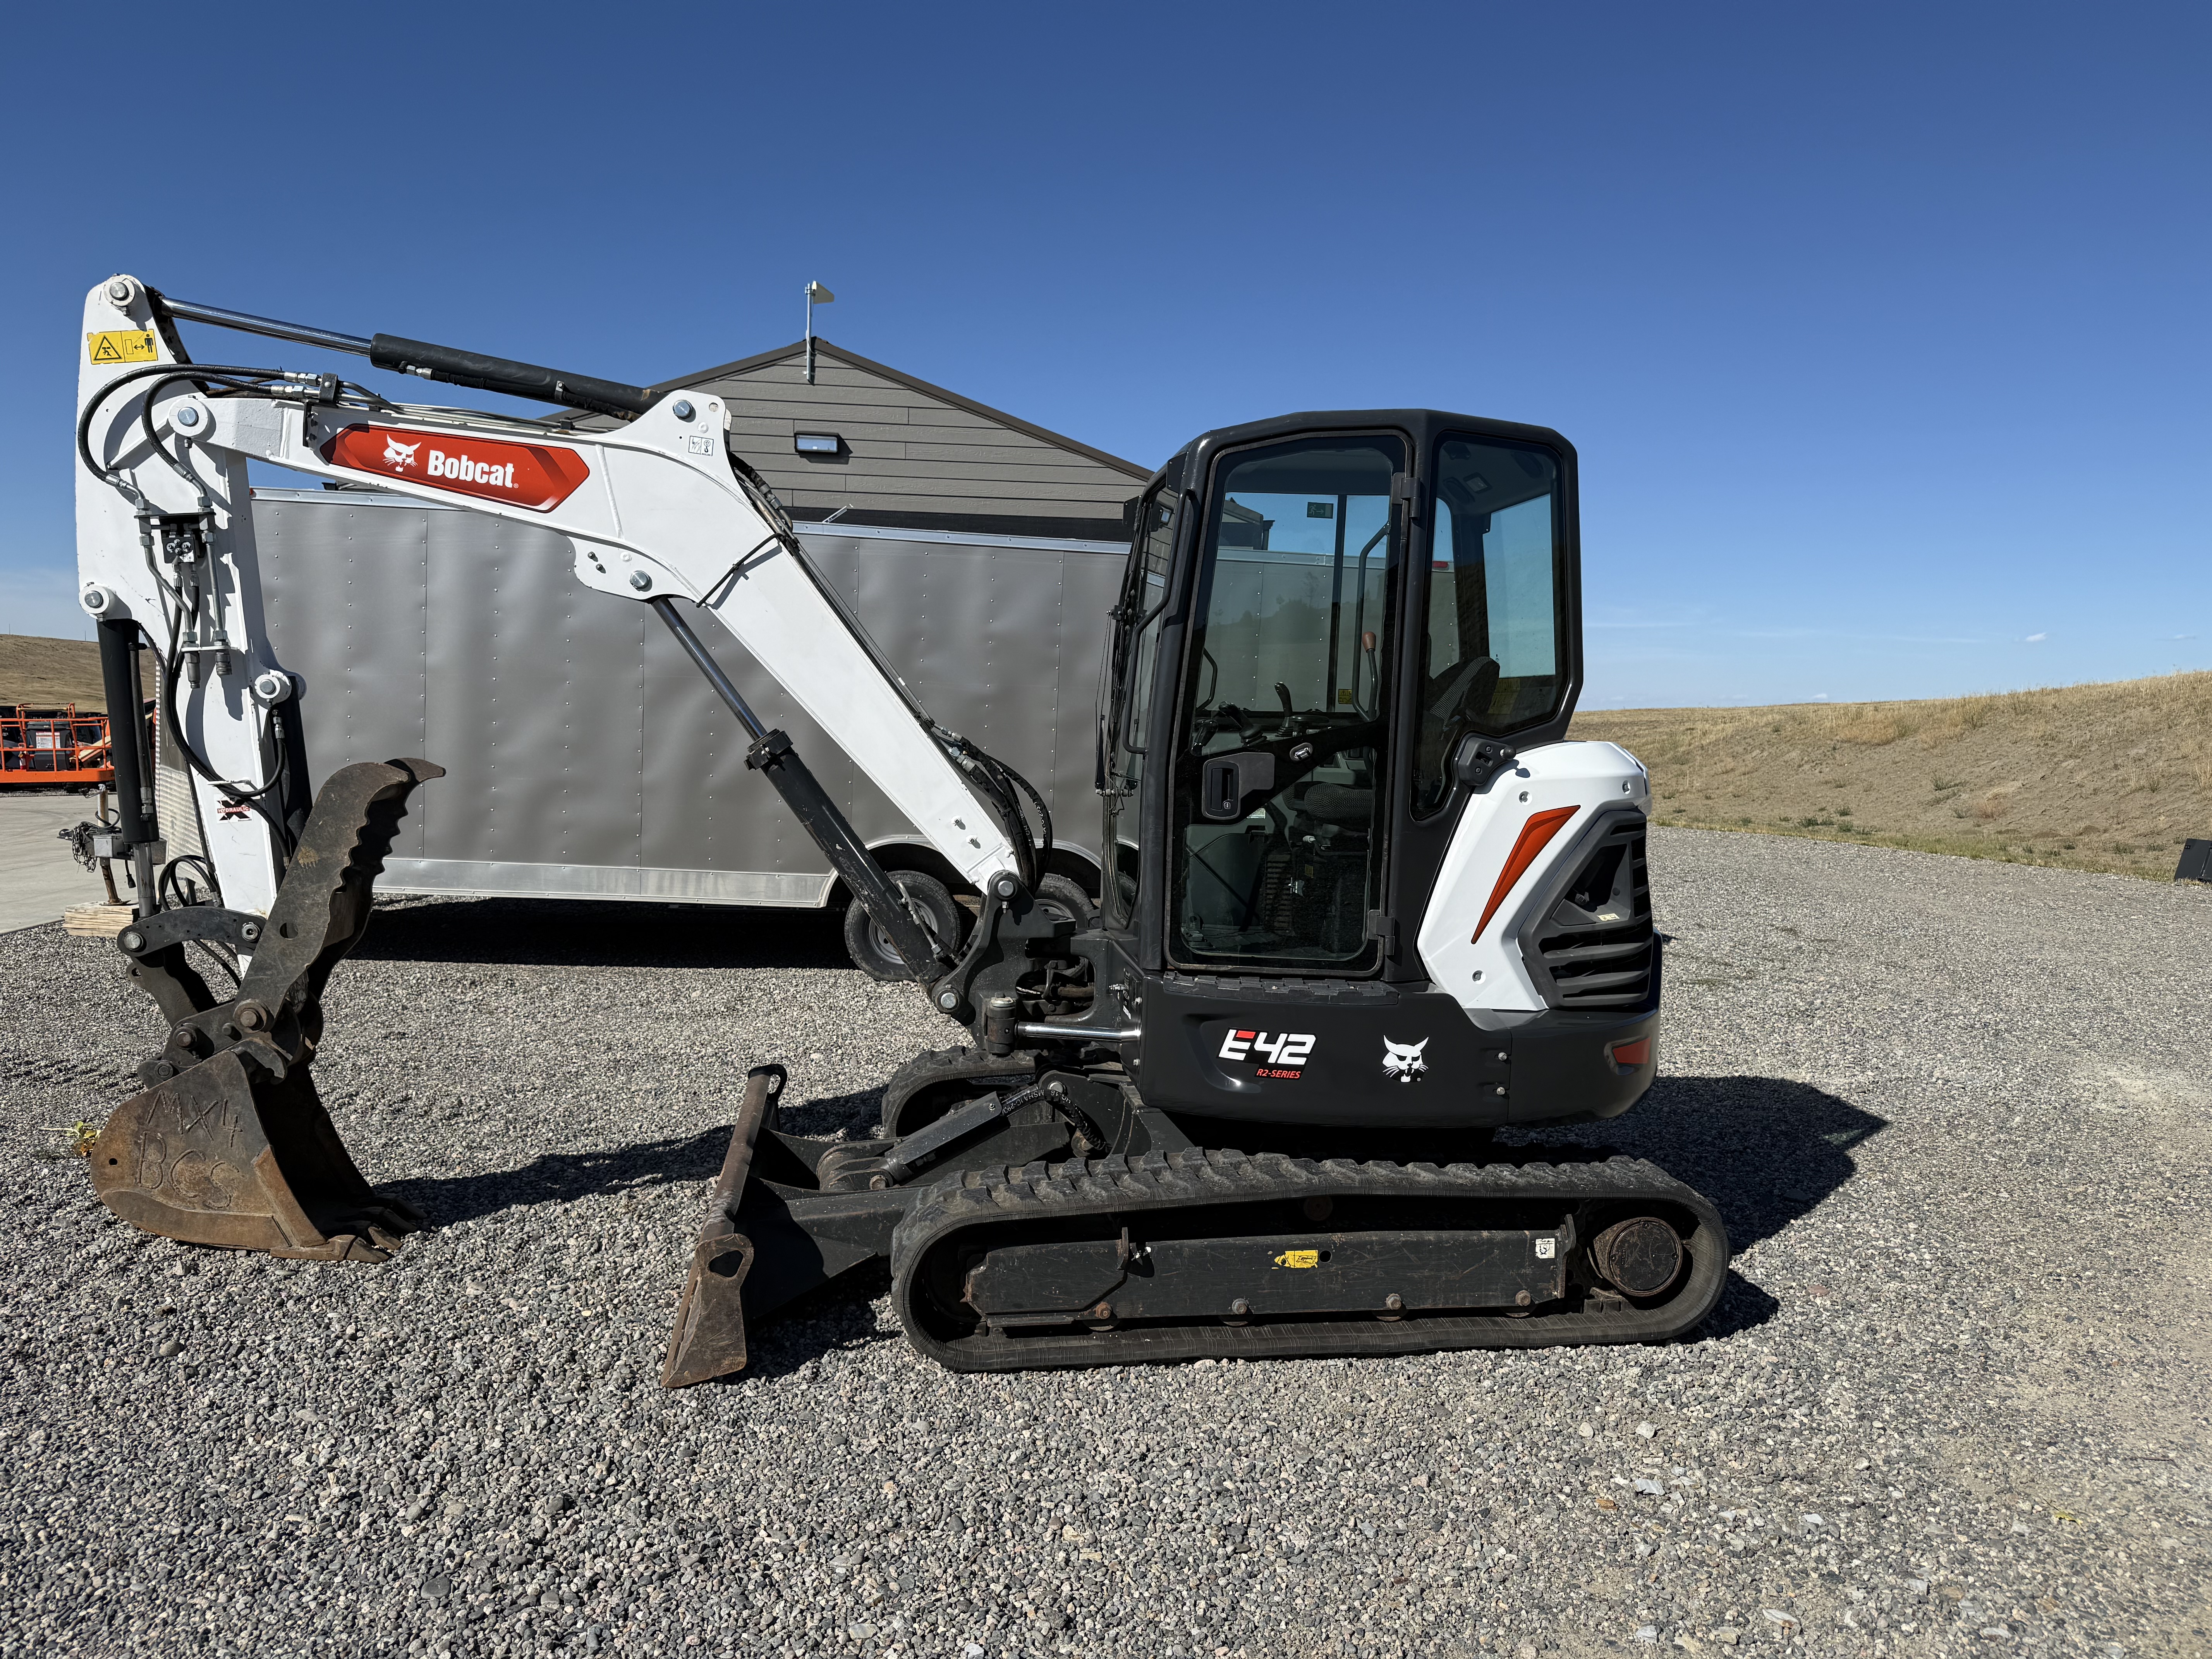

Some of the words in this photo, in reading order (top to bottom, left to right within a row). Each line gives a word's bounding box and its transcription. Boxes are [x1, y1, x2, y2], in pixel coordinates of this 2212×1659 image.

[1219, 1029, 1316, 1065] E42
[1256, 1068, 1301, 1079] R2-SERIES
[1024, 1090, 1044, 1101] MSHA
[1000, 1099, 1023, 1116] IC-293/
[137, 1131, 239, 1208] BCS
